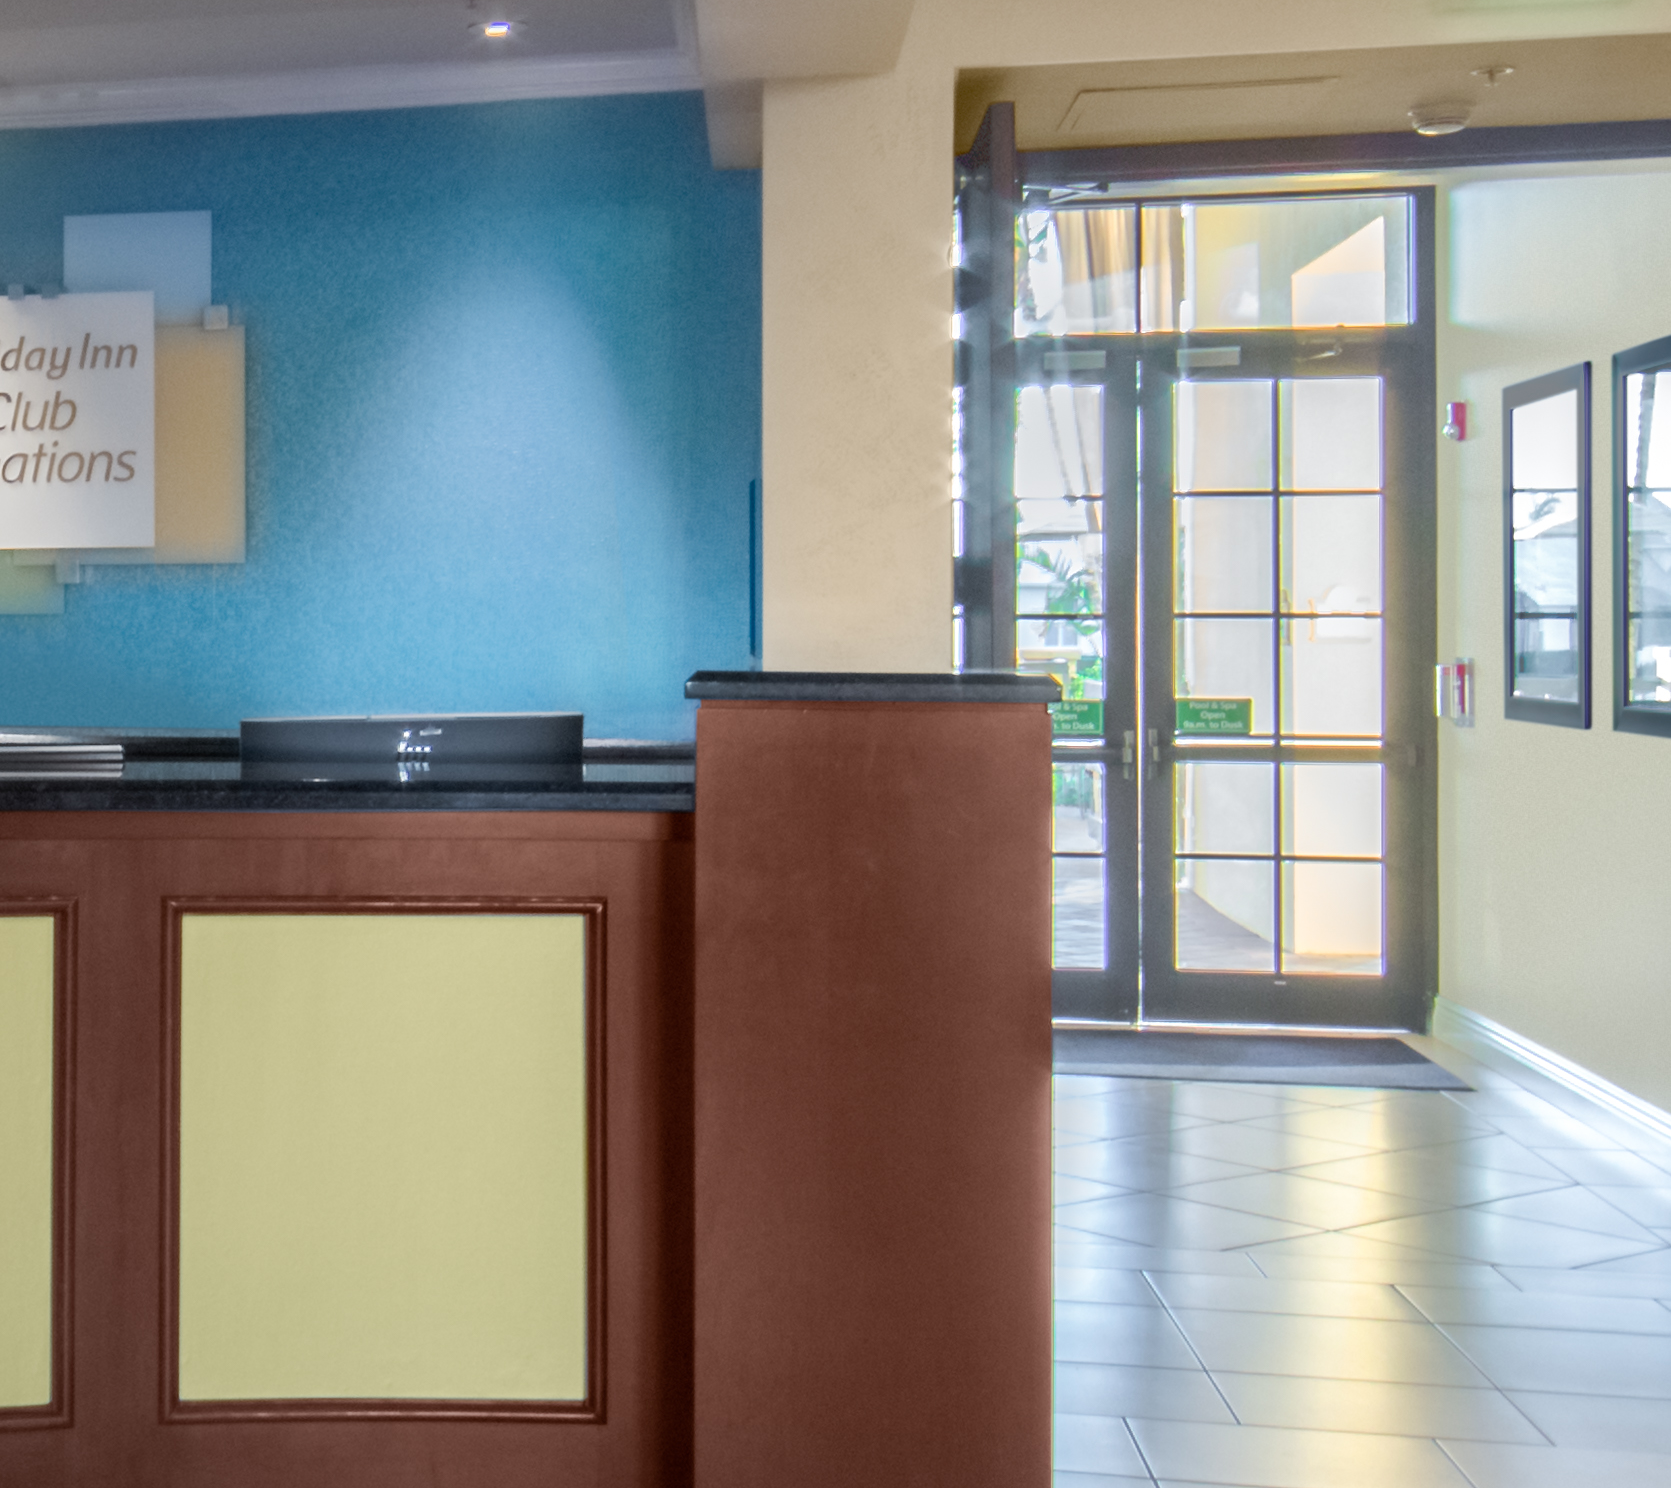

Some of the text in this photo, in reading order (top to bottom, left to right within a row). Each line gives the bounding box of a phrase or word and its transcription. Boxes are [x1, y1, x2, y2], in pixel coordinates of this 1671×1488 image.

[79, 332, 138, 370] Inn
[1072, 703, 1088, 712] Spa
[1189, 701, 1210, 710] Pool
[1222, 701, 1237, 711] Spa
[1052, 713, 1078, 723] Open
[1200, 711, 1226, 721] Open
[1061, 722, 1072, 730] to
[1073, 721, 1095, 731] Dusk
[1208, 721, 1219, 729] to
[1220, 720, 1244, 729] Dusk
